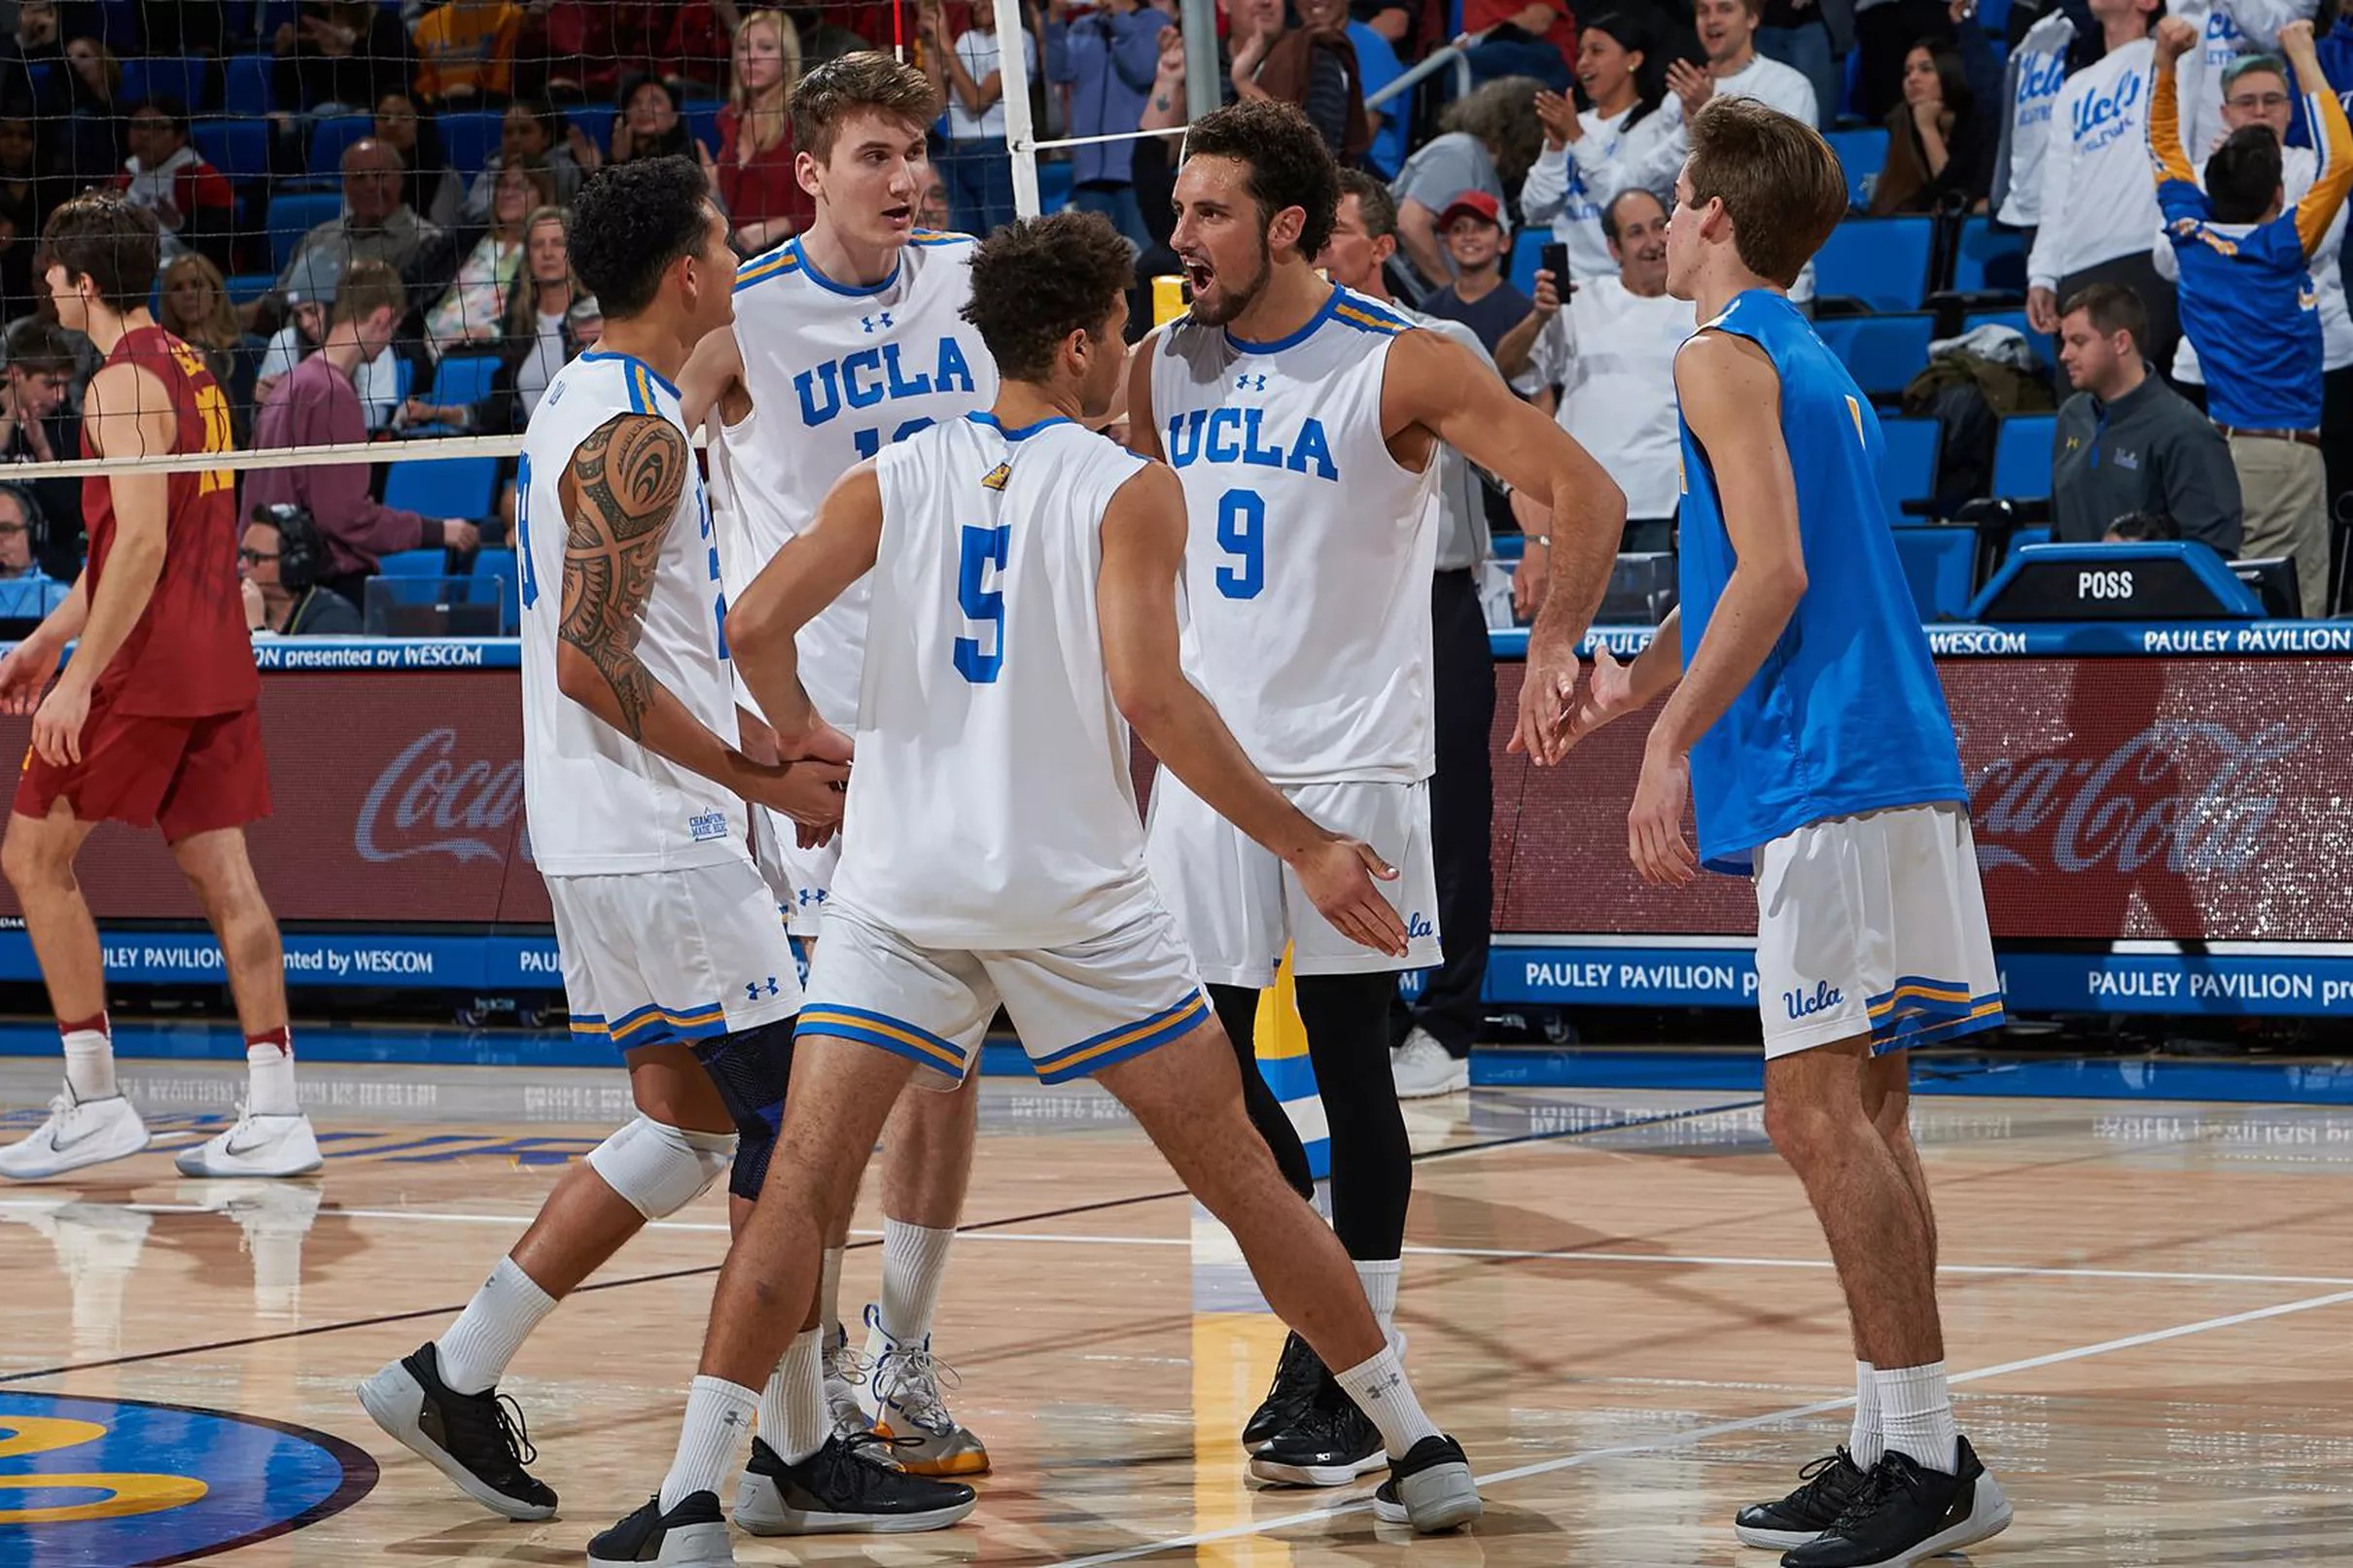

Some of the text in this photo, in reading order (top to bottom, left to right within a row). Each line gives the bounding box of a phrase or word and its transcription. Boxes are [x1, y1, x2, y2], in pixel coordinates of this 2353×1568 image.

[793, 336, 975, 428] UCLA
[1169, 407, 1338, 481] UCLA
[1215, 488, 1265, 600] 9
[2079, 572, 2133, 599] POSS
[952, 523, 1011, 683] 5
[1929, 632, 2026, 654] WESCOM
[2143, 629, 2352, 652] PAULEY PAVILION
[286, 646, 372, 669] presented
[377, 647, 400, 669] by
[404, 645, 482, 666] WESCOM
[1408, 912, 1433, 939] la
[328, 949, 350, 975] by
[354, 950, 433, 973] WESCOM
[1526, 962, 1612, 988] PAULEY
[1620, 964, 1734, 990] PAVILION
[2089, 970, 2182, 996] PAULEY
[2190, 974, 2313, 1000] PAVILION
[1782, 980, 1844, 1020] Ucla
